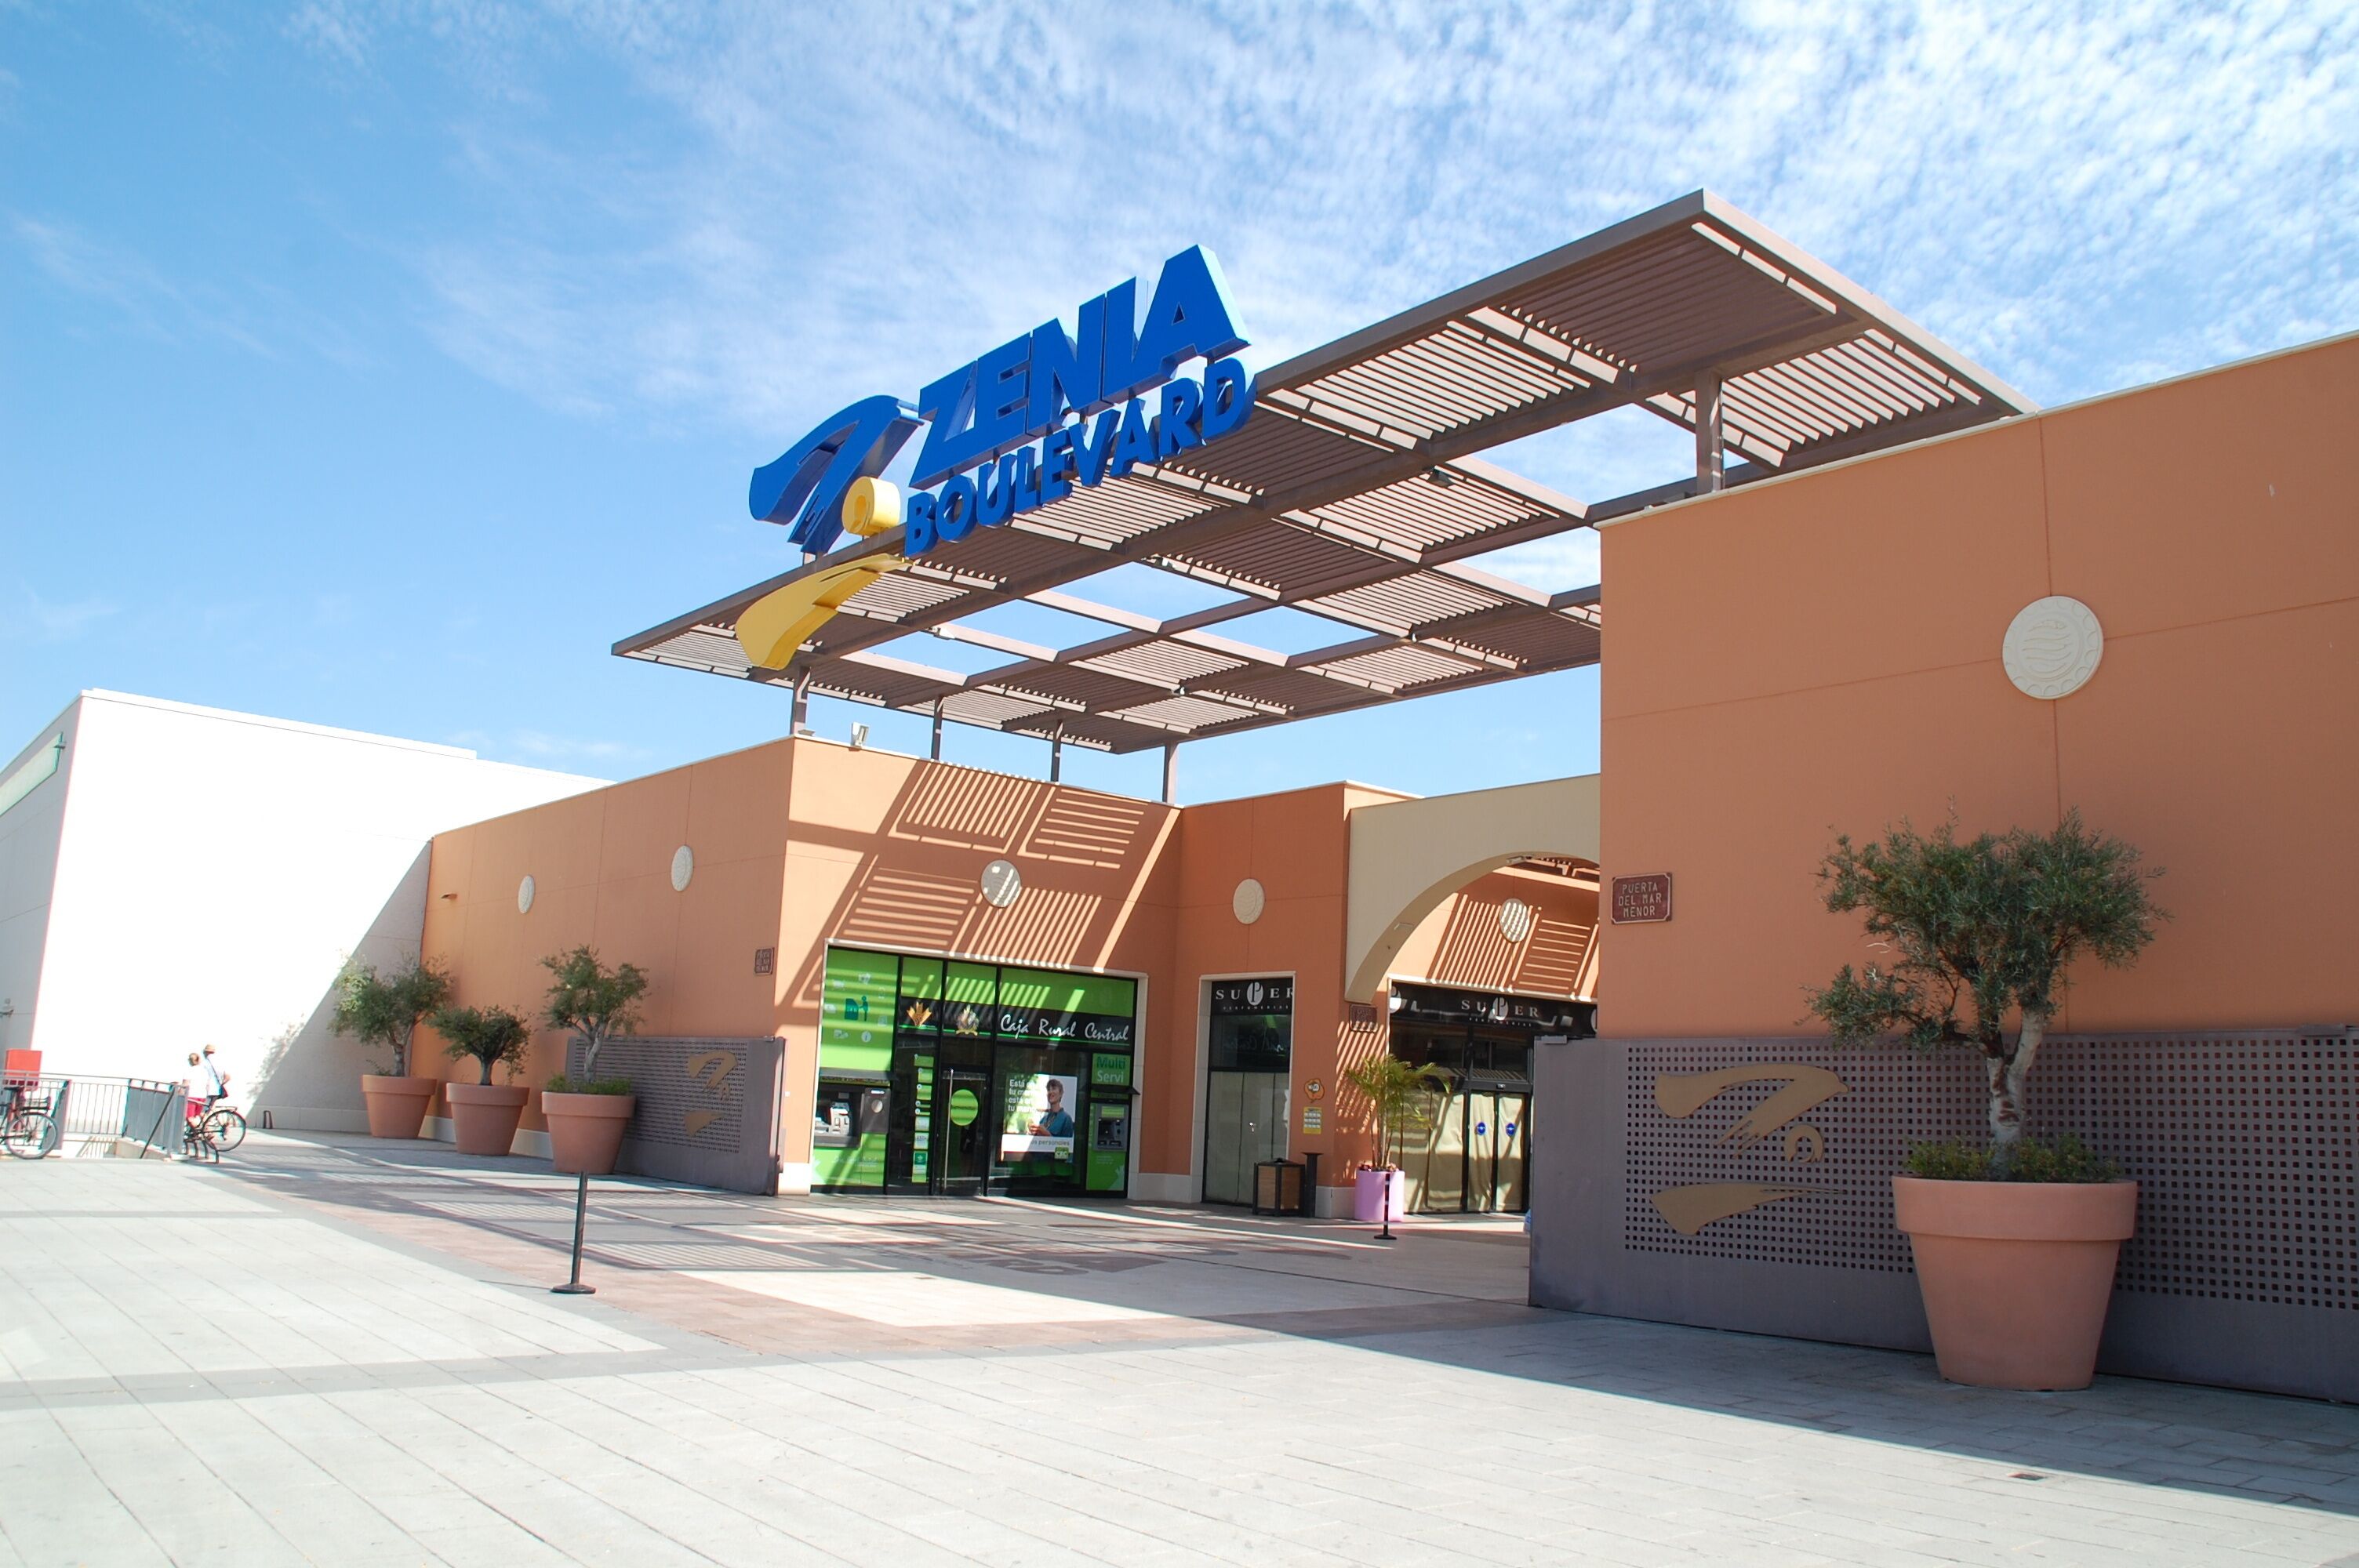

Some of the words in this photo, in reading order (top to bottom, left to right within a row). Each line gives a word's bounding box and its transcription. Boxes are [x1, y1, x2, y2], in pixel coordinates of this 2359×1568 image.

[908, 245, 1252, 489] ZENIA
[903, 357, 1255, 557] BOULEVARD
[1622, 881, 1658, 895] PUERTA
[1618, 894, 1636, 906] DEL
[1642, 892, 1662, 904] MAR
[1623, 906, 1656, 918] MENOR
[1000, 1014, 1029, 1040] Caja
[1038, 1018, 1077, 1036] Rural
[1085, 1022, 1129, 1041] Central
[1096, 1056, 1126, 1069] Multi
[1009, 1079, 1025, 1087] Está
[1096, 1070, 1125, 1083] Servi
